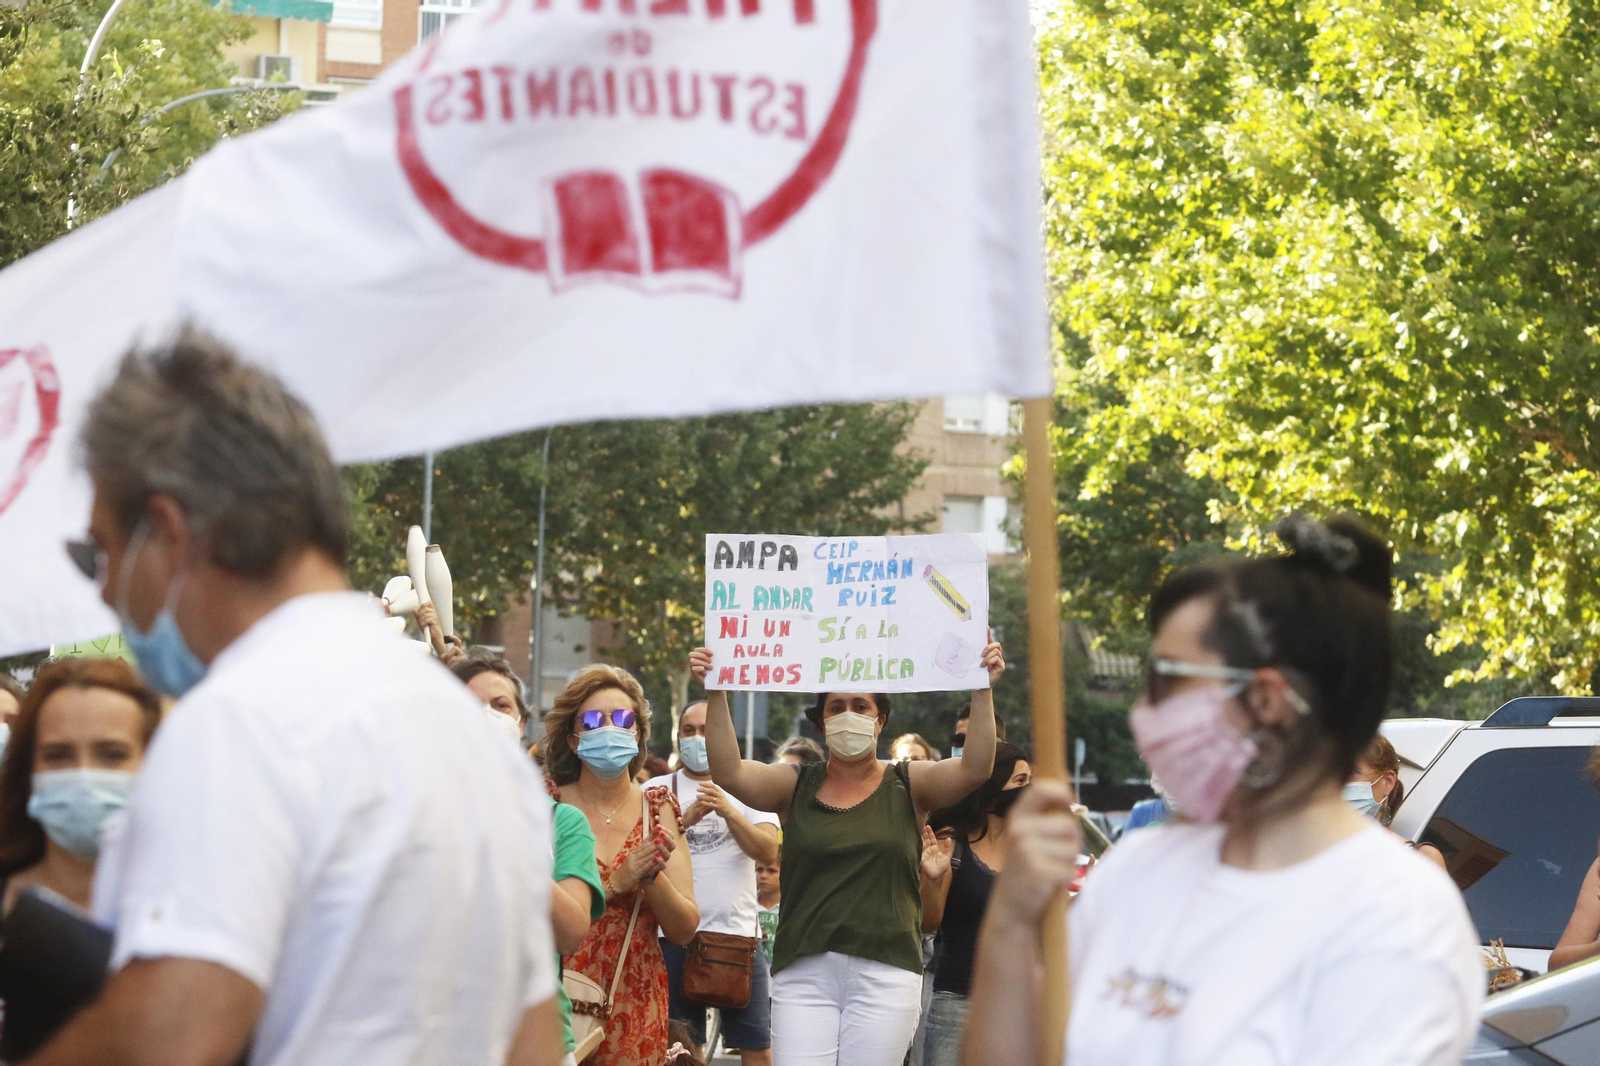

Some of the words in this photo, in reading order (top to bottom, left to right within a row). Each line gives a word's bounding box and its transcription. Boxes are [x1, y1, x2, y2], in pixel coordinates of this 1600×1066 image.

[713, 540, 799, 571] AMPA
[826, 552, 913, 585] HERNÁN
[709, 580, 741, 611] AL
[752, 585, 814, 613] ANDAR
[763, 618, 791, 638] UN
[733, 643, 784, 659] AULA
[717, 663, 802, 686] MENOS
[818, 652, 915, 684] PÚBLICA
